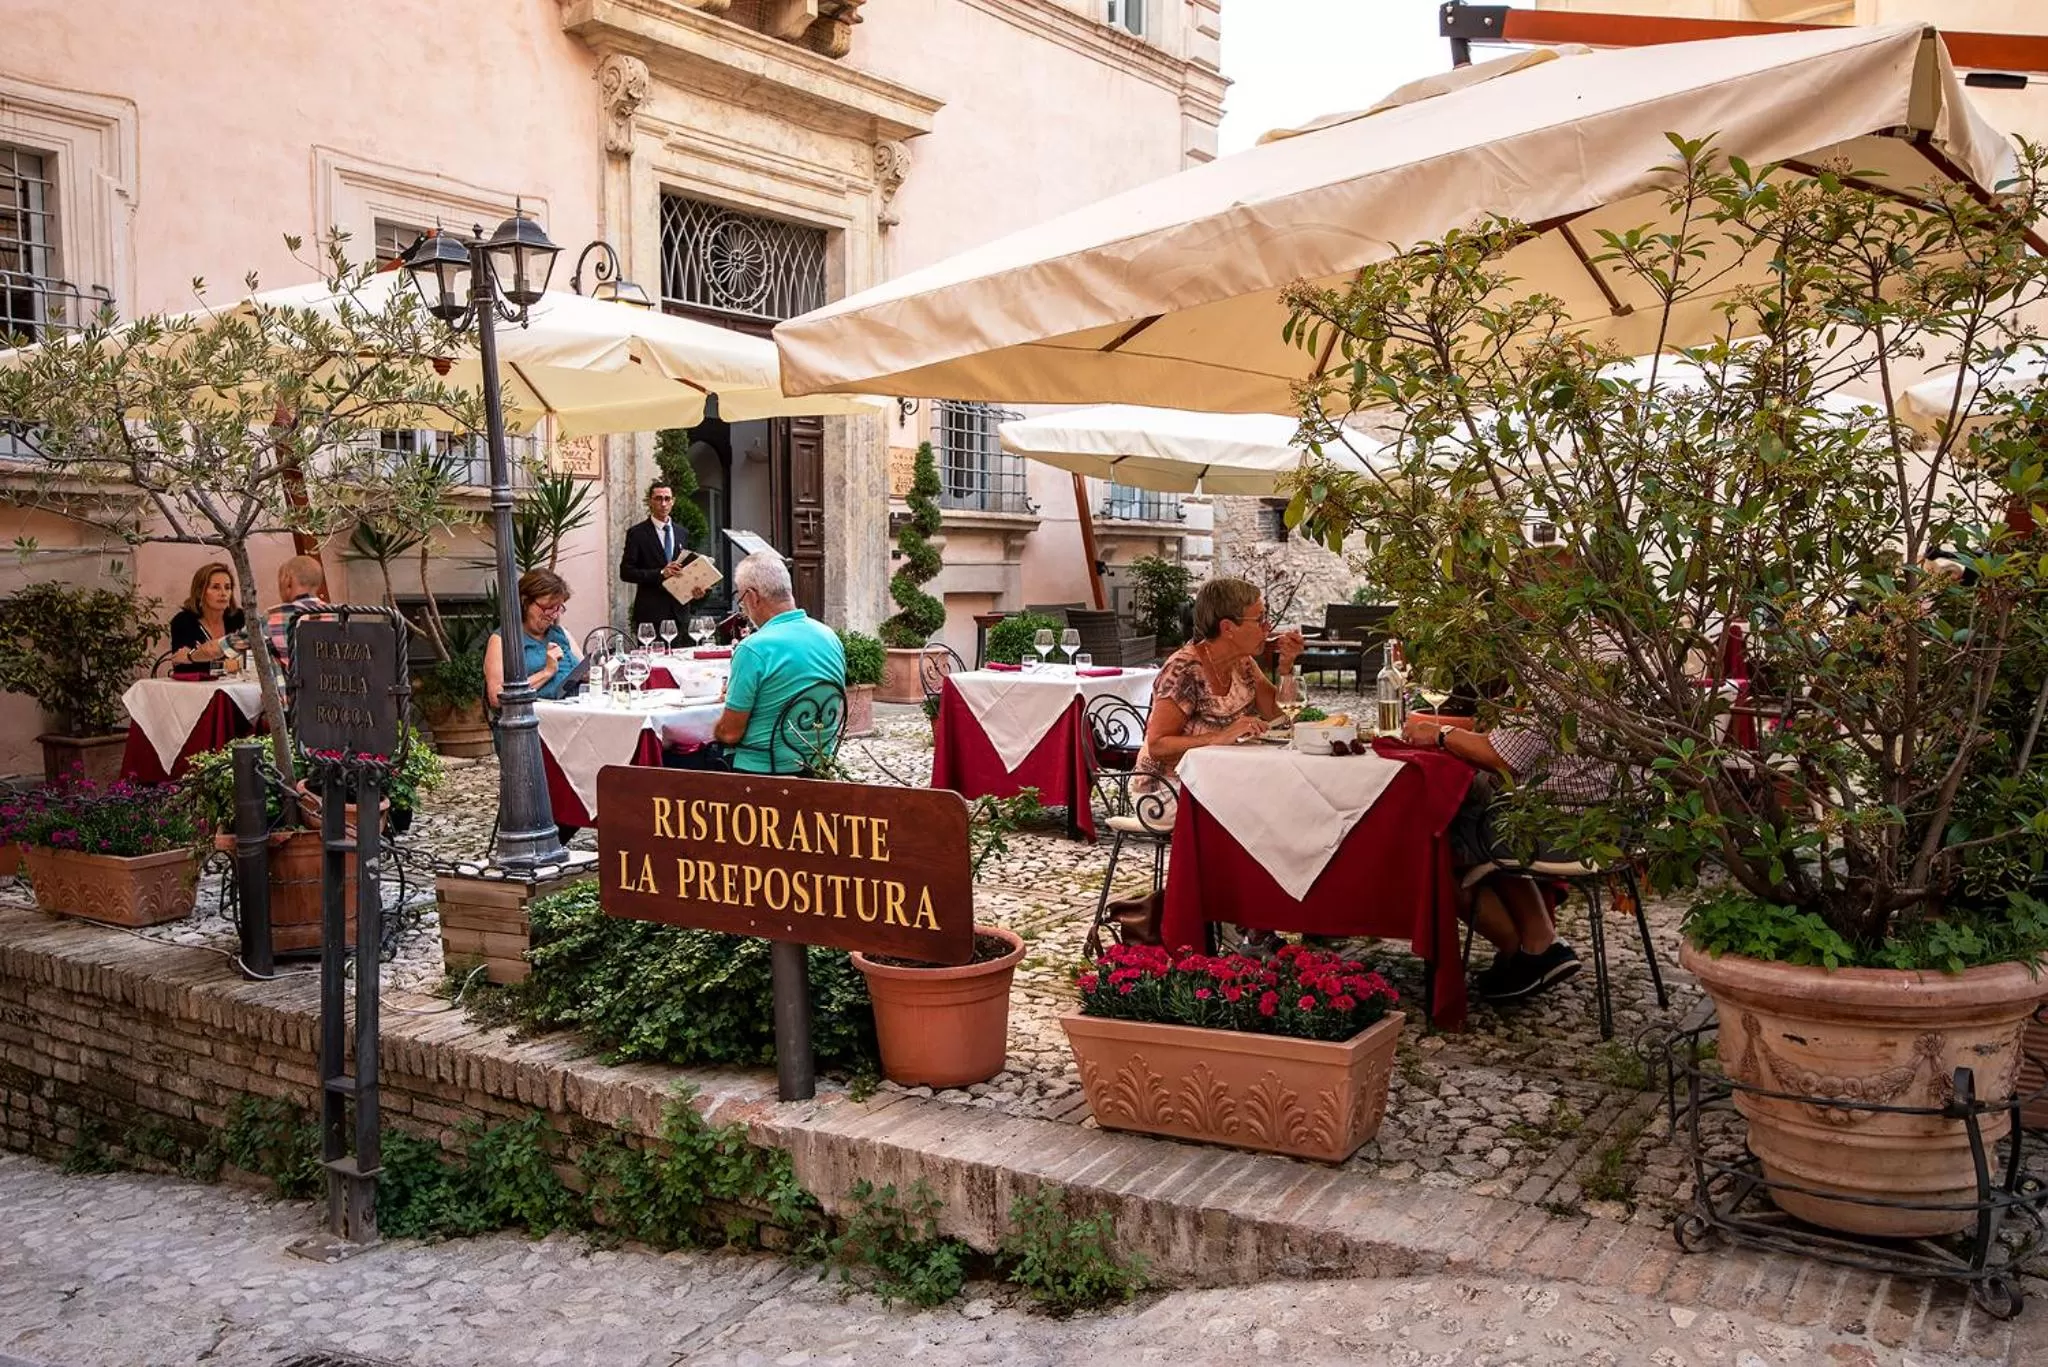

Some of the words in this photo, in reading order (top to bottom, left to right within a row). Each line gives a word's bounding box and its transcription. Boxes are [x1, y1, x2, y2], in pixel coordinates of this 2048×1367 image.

[315, 641, 372, 660] PIAZZA
[319, 673, 368, 695] DELLA
[317, 704, 374, 728] ROCCA
[652, 797, 890, 862] RISTORANTE
[618, 850, 659, 894] LA
[677, 858, 942, 930] PREPOSITURA
